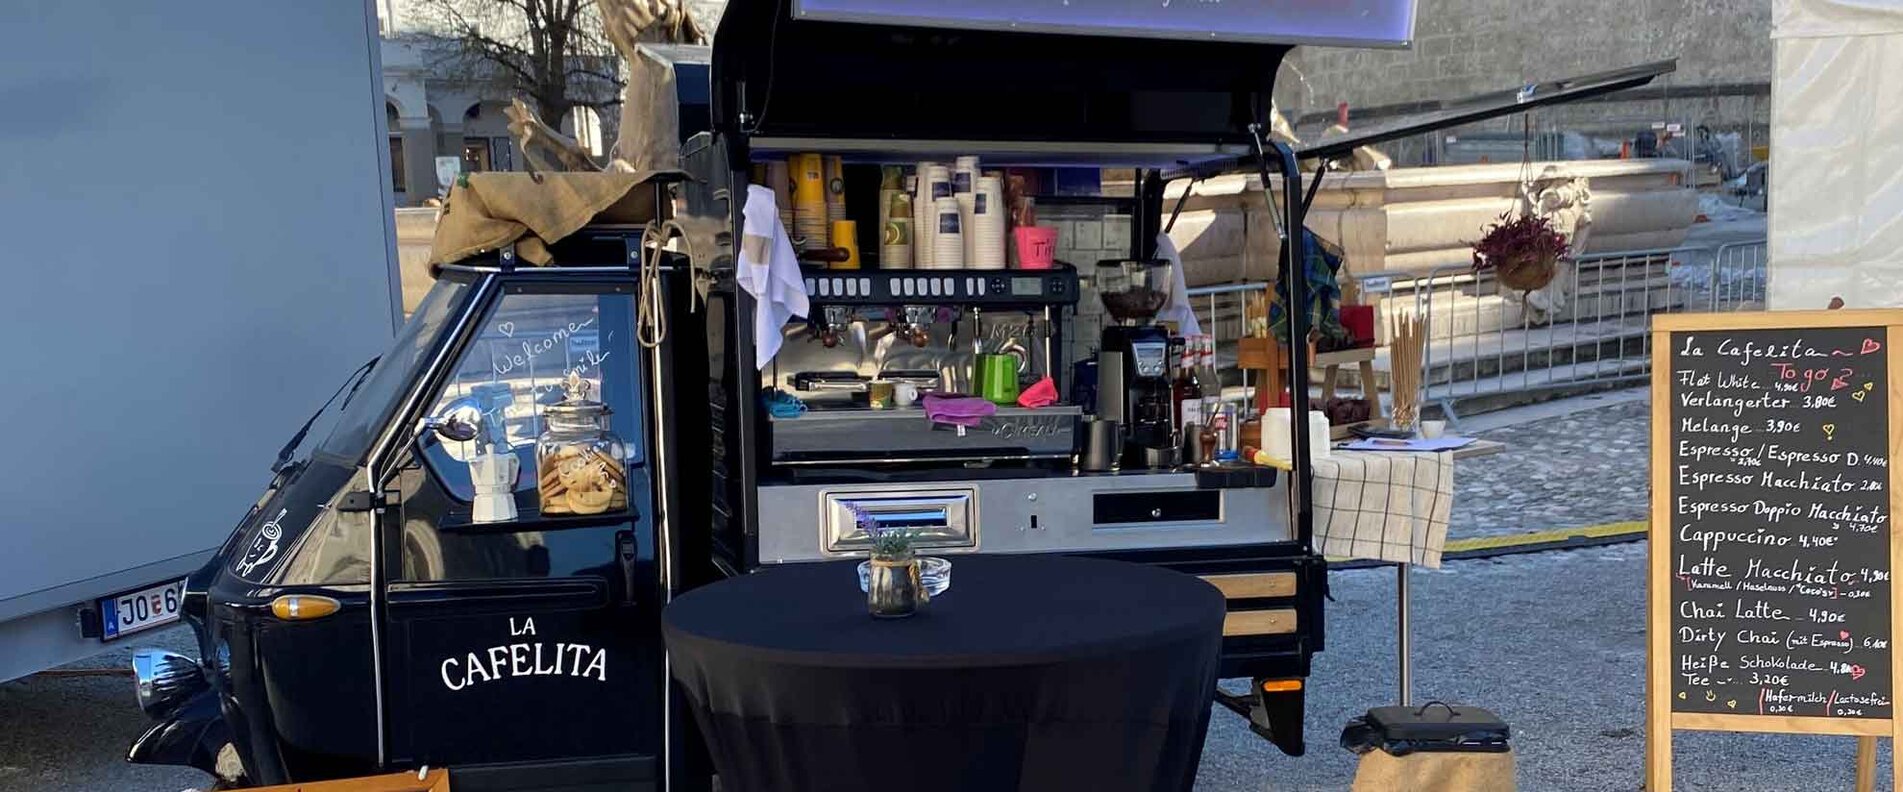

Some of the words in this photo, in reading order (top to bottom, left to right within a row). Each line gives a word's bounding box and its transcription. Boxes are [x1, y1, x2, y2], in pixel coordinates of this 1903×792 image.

[493, 318, 593, 375] Welcome
[1680, 336, 1704, 357] La
[1717, 338, 1829, 366] Cafelita
[1676, 370, 1711, 388] Flat
[1718, 371, 1761, 389] White
[1770, 363, 1796, 380] To
[1681, 417, 1753, 443] Melange
[1765, 419, 1801, 434] 3,90€
[1679, 440, 1755, 461] Espresso
[1768, 444, 1841, 467] Espresso
[1679, 465, 1754, 490] Espresso
[1760, 471, 1855, 493] Macchiato
[1678, 495, 1750, 520] Espresso
[1753, 500, 1802, 522] Doppio
[1808, 503, 1888, 524] Macchiato
[1680, 524, 1792, 551] Cappuccino
[1679, 554, 1732, 578] Latte
[1745, 559, 1856, 585] Macchiato
[1680, 601, 1725, 619] Chai
[1735, 598, 1790, 620] Latte
[1809, 608, 1846, 623] 4,90€
[509, 617, 536, 636] LA
[1678, 626, 1727, 651] Dirty
[1737, 630, 1780, 645] Chai
[441, 643, 606, 691] CAFELITA
[1681, 672, 1711, 687] Tee
[1750, 673, 1790, 687] 3,20€
